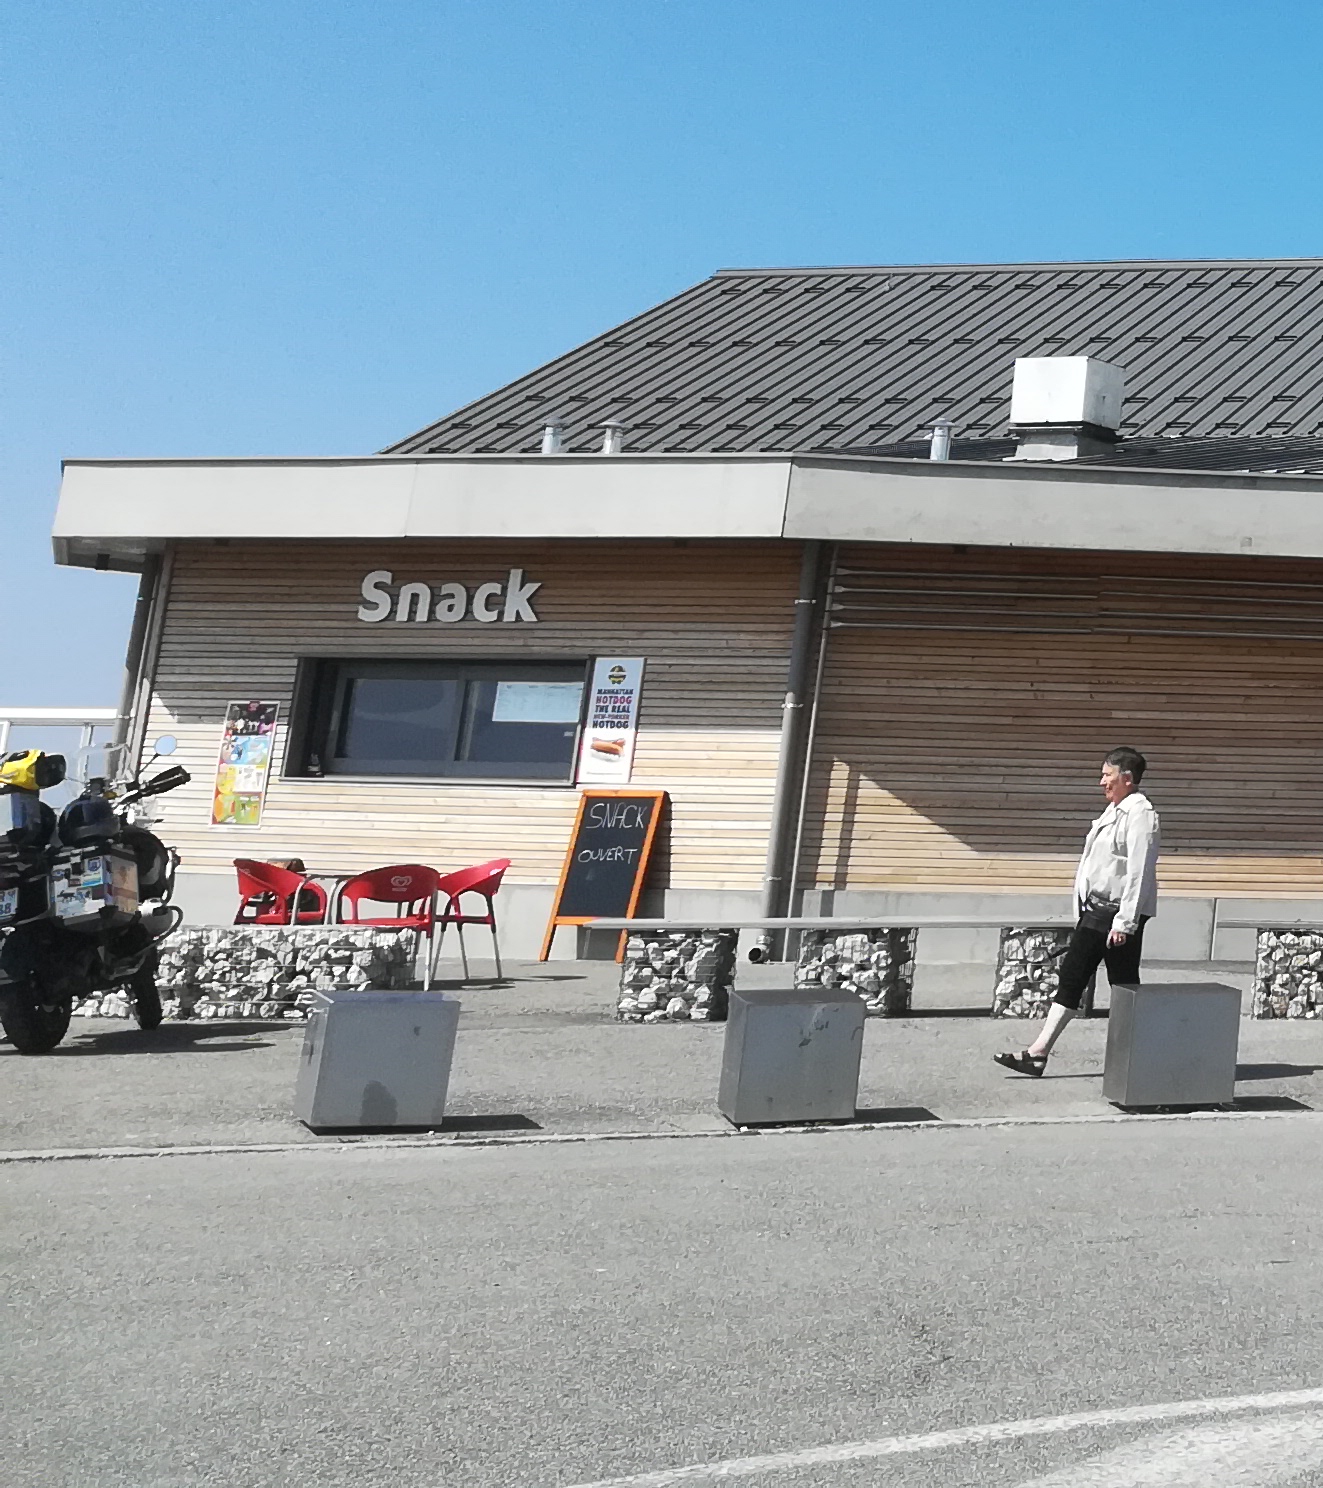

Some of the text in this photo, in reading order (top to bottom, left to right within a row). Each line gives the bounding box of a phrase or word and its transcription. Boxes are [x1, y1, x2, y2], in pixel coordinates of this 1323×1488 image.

[358, 568, 542, 623] Snack
[595, 695, 633, 705] HOTDOG
[594, 705, 631, 714] THE REAL
[592, 720, 629, 729] HOTDOG
[585, 802, 648, 829] SNACK
[577, 845, 638, 865] OUVERT
